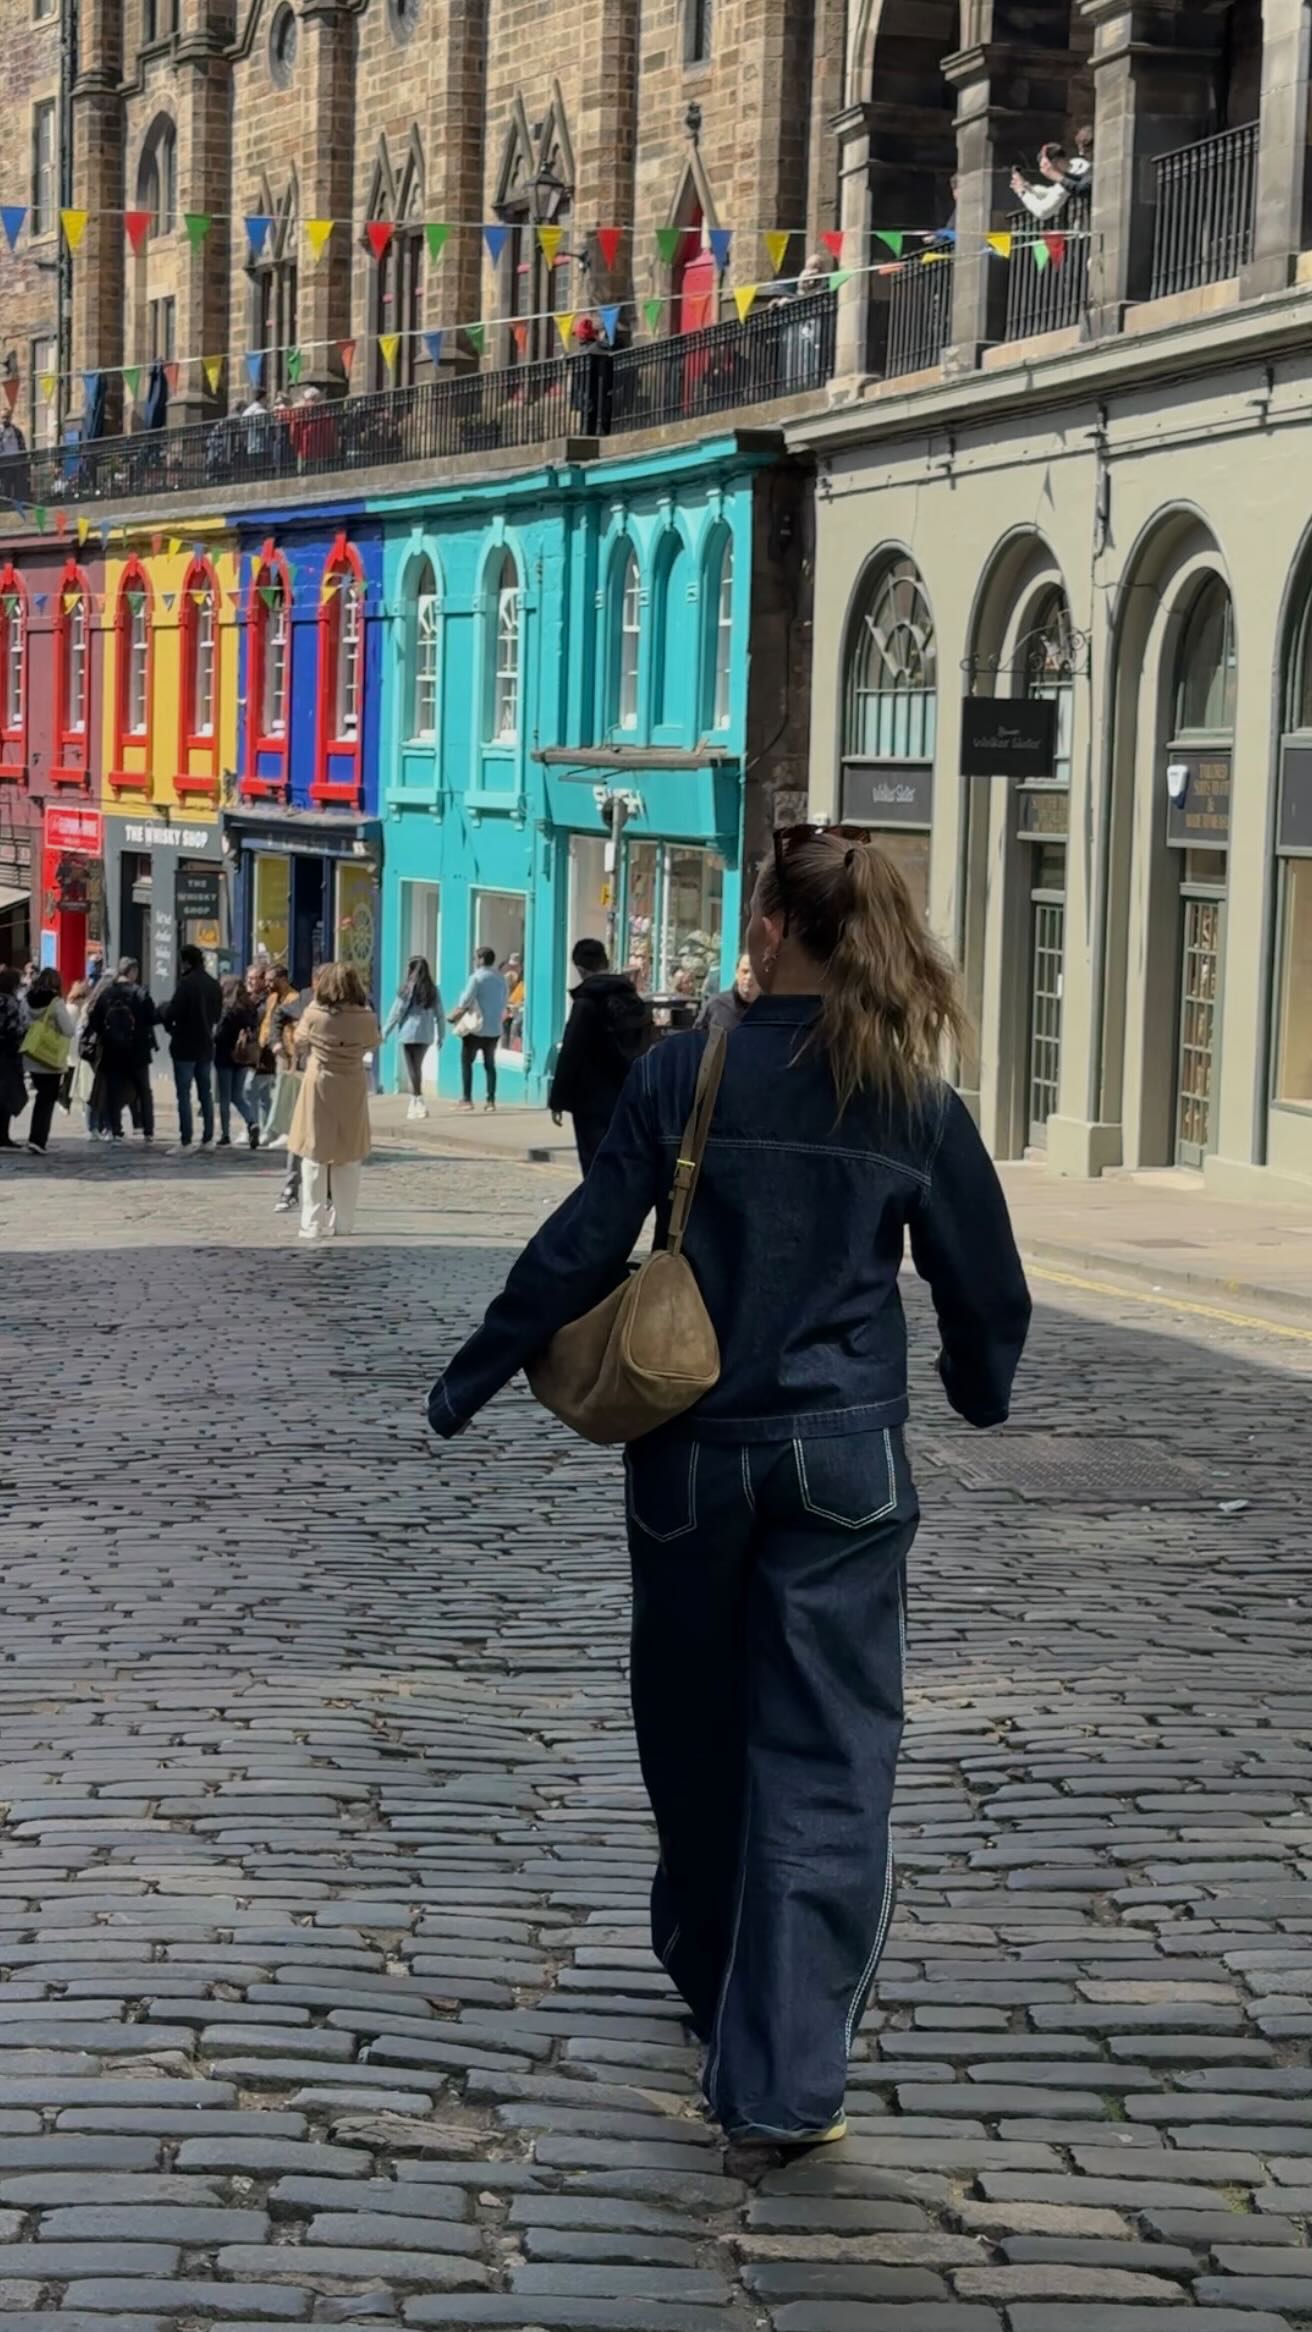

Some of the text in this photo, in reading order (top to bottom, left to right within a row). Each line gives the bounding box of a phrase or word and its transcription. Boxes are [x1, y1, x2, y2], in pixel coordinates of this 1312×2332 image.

[125, 825, 208, 848] THE WHISKY SHOP
[187, 879, 207, 888] THE
[177, 892, 217, 901] WHISKY
[183, 906, 210, 915] SHOP
